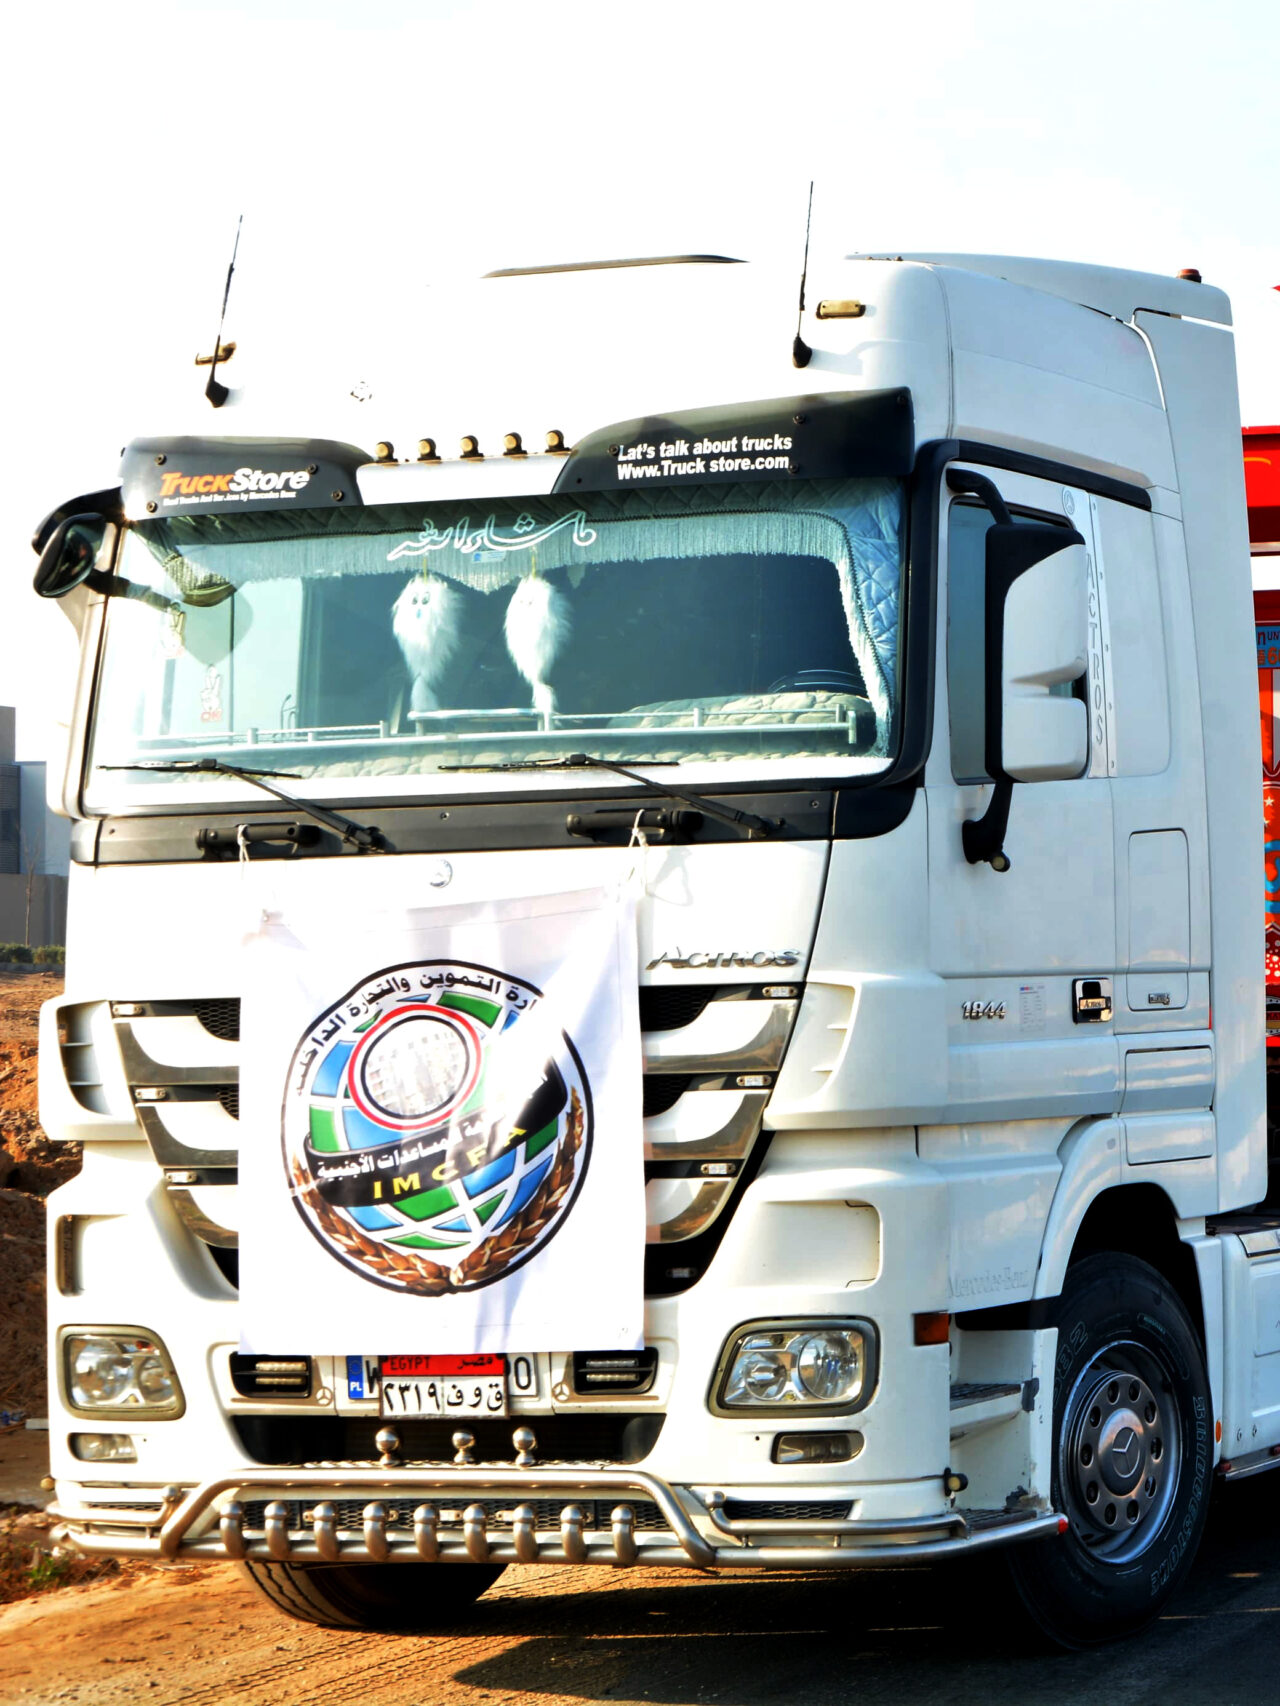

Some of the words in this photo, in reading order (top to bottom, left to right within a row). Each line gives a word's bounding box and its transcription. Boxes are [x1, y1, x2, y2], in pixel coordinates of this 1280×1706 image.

[617, 444, 655, 462] Lat's
[659, 439, 690, 458] talk
[693, 436, 737, 455] about
[741, 433, 793, 451] trucks
[709, 456, 790, 473] store.com
[961, 1000, 1007, 1021] 1844
[390, 1356, 431, 1371] EGYPT
[457, 1355, 493, 1370] مصر
[350, 1382, 363, 1392] PL
